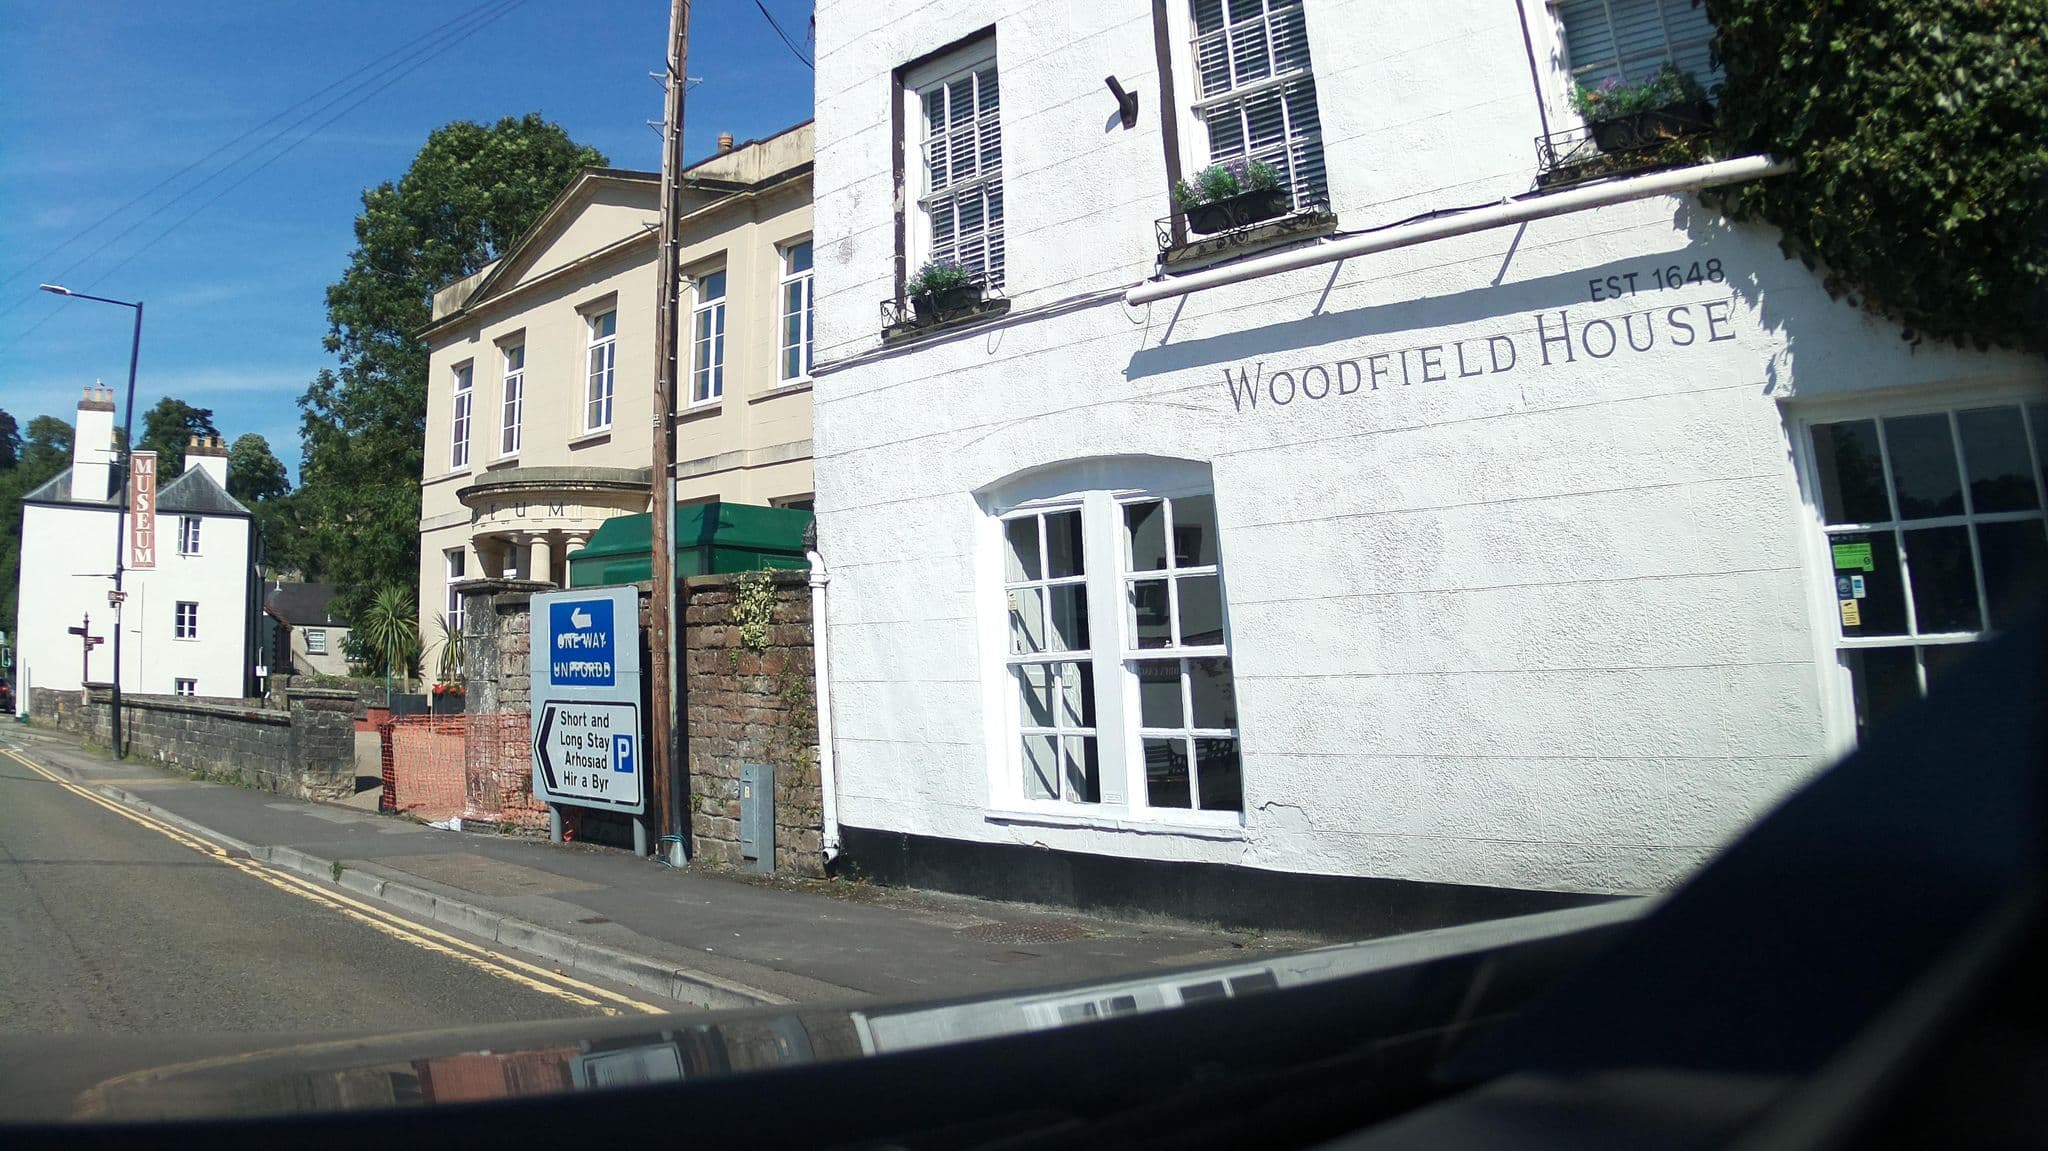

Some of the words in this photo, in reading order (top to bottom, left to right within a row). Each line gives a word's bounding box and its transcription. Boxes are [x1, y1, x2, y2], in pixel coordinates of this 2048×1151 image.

[1589, 272, 1639, 302] EST
[1652, 258, 1725, 292] 1648
[1222, 334, 1517, 412] WOODFIELD
[1537, 300, 1736, 366] HOUSE
[135, 458, 153, 562] MUSEUM
[557, 633, 579, 649] ONE
[583, 632, 607, 648] WAY
[560, 710, 587, 727] Short
[591, 713, 610, 728] and
[560, 731, 583, 750] Long
[587, 732, 610, 752] Stay
[565, 751, 607, 769] Arhosiad
[617, 738, 630, 769] P
[564, 771, 578, 786] Hir
[581, 776, 588, 788] a
[592, 774, 609, 792] Byr
